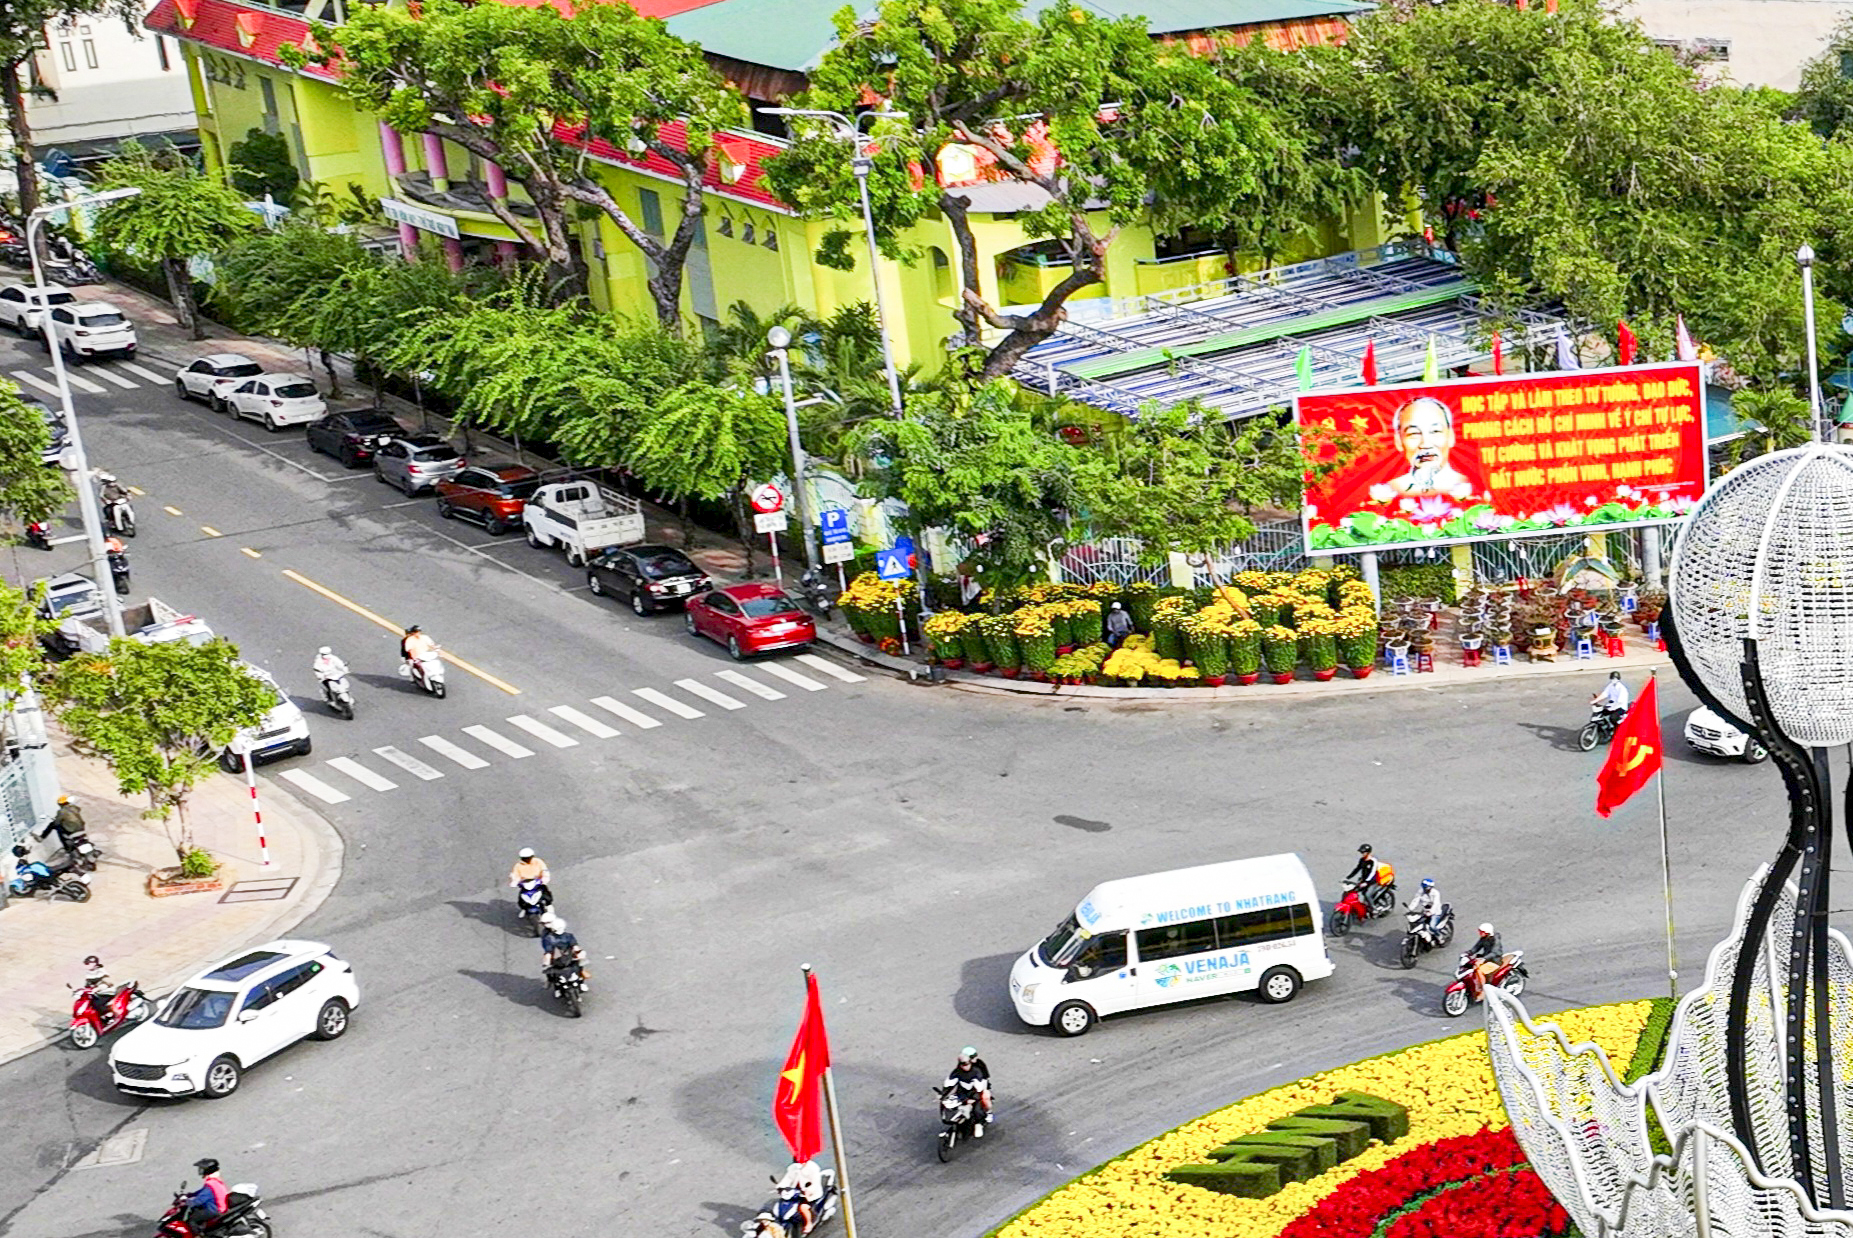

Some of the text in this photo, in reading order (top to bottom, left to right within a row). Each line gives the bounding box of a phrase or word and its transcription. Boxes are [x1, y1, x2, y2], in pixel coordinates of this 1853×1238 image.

[1487, 391, 1508, 414] TẬP
[1511, 390, 1526, 410] VÀ
[1528, 388, 1552, 408] LÀM
[1555, 388, 1582, 406] THEO
[1463, 421, 1502, 439] PHONG
[1504, 417, 1534, 436] CÁCH
[1554, 412, 1573, 432] CHÍ
[1625, 408, 1630, 426] Ý
[1634, 406, 1652, 426] CHÍ
[1654, 406, 1668, 426] TỰ
[1555, 438, 1583, 457] KHÁT
[1618, 433, 1645, 453] PHÁT
[827, 512, 840, 527] P
[1156, 891, 1296, 923] WELCOME TO NHATRANG
[1184, 952, 1250, 974] VENAJA
